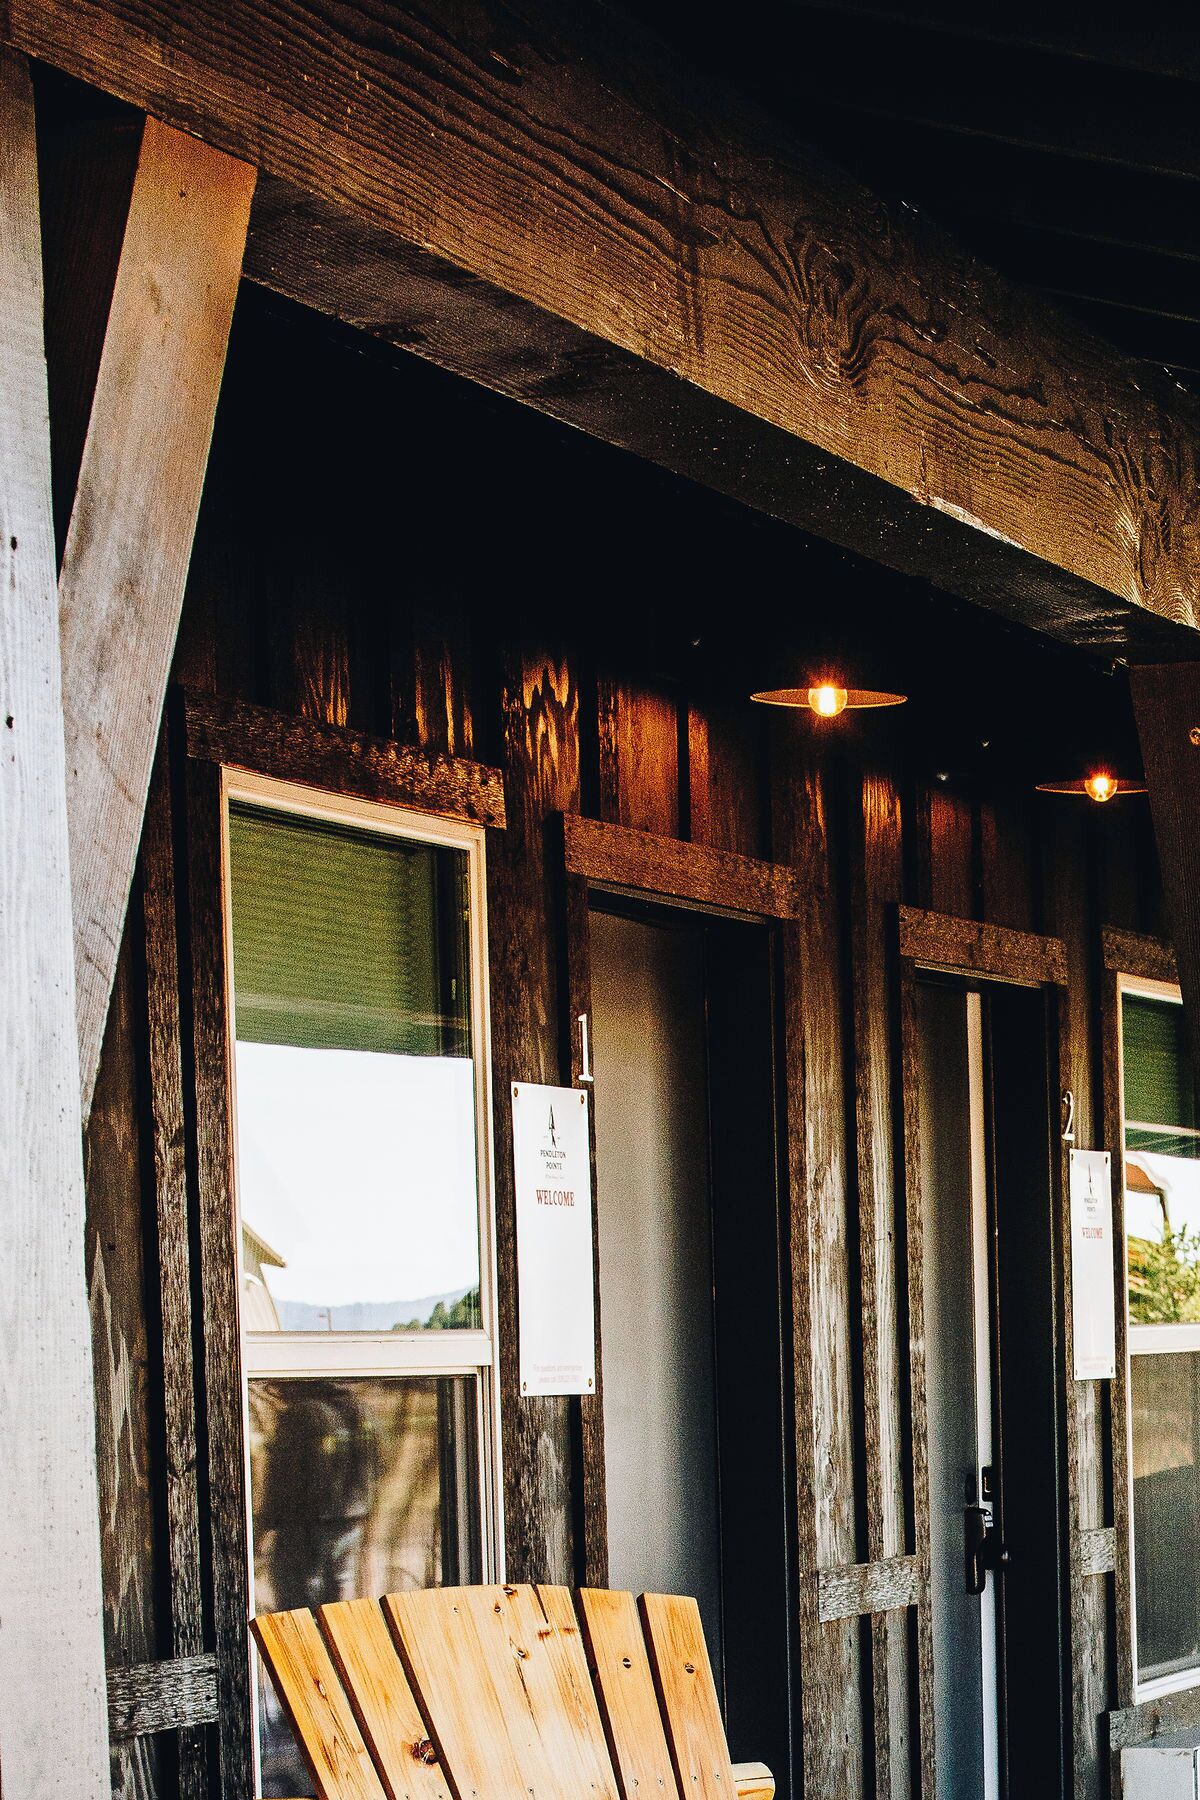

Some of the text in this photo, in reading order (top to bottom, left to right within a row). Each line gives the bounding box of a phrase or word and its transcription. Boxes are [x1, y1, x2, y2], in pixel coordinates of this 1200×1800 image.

[578, 1013, 594, 1082] 1
[1062, 1090, 1075, 1141] 2
[540, 1149, 566, 1159] PENDLETON
[545, 1161, 563, 1170] POINTE
[536, 1189, 575, 1207] WELCOME
